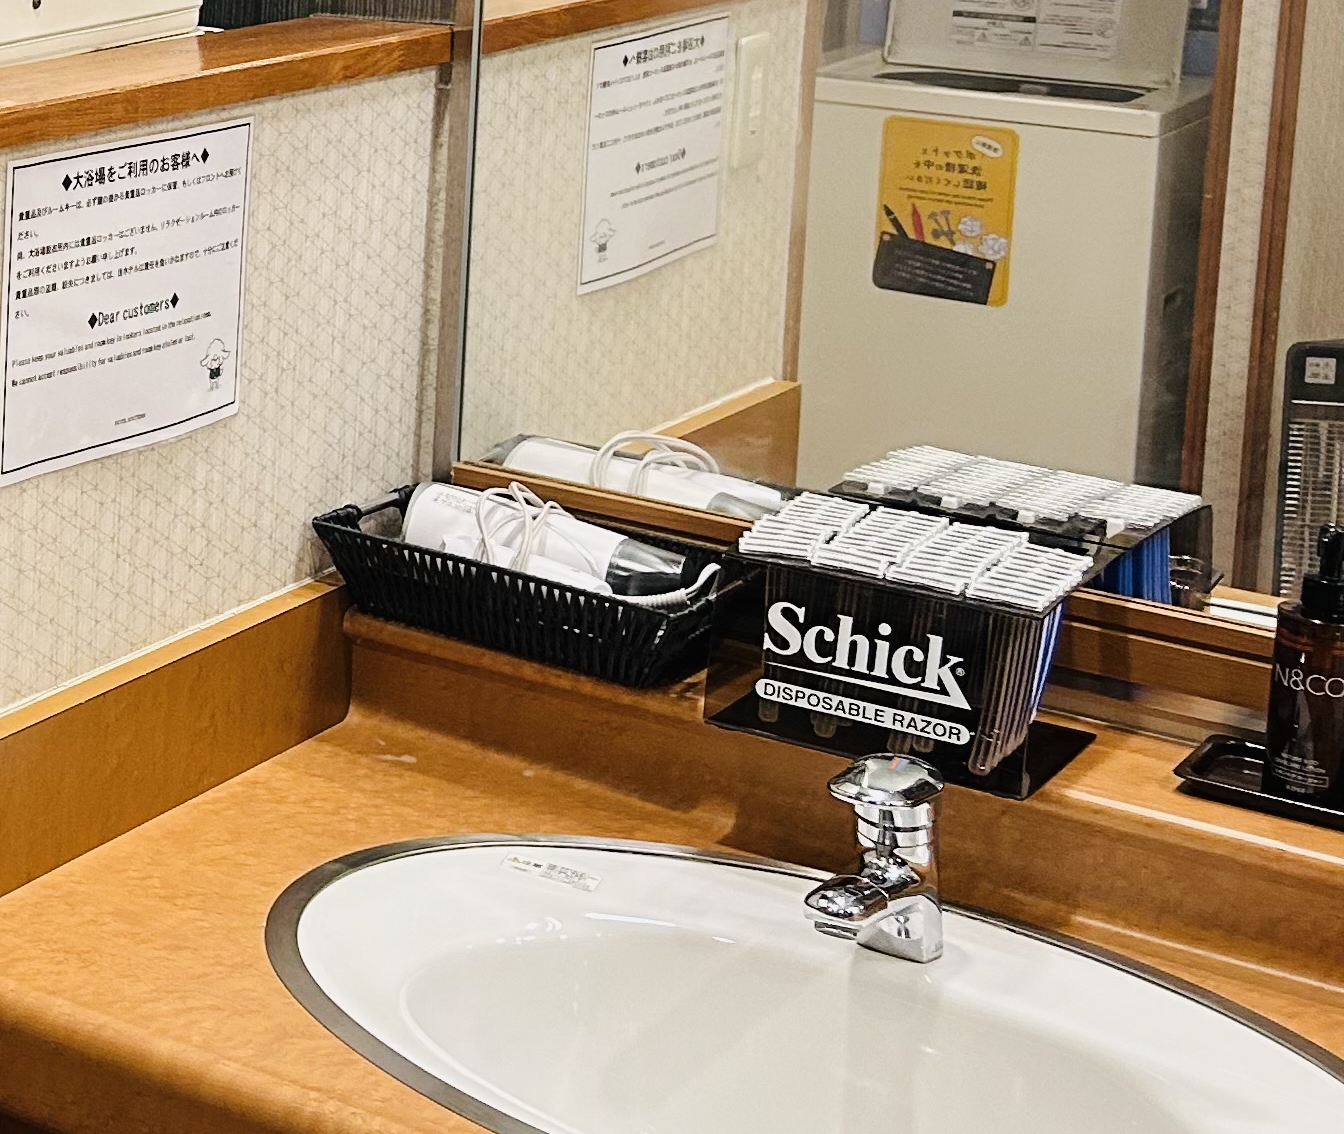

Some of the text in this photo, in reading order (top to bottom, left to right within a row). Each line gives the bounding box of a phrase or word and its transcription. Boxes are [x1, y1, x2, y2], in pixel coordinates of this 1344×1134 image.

[72, 149, 201, 191] 大浴場をご利用のお客様へ
[98, 298, 170, 327] Dear customers
[763, 601, 967, 692] Schick
[763, 682, 962, 742] DISPOSABLE RAZOR
